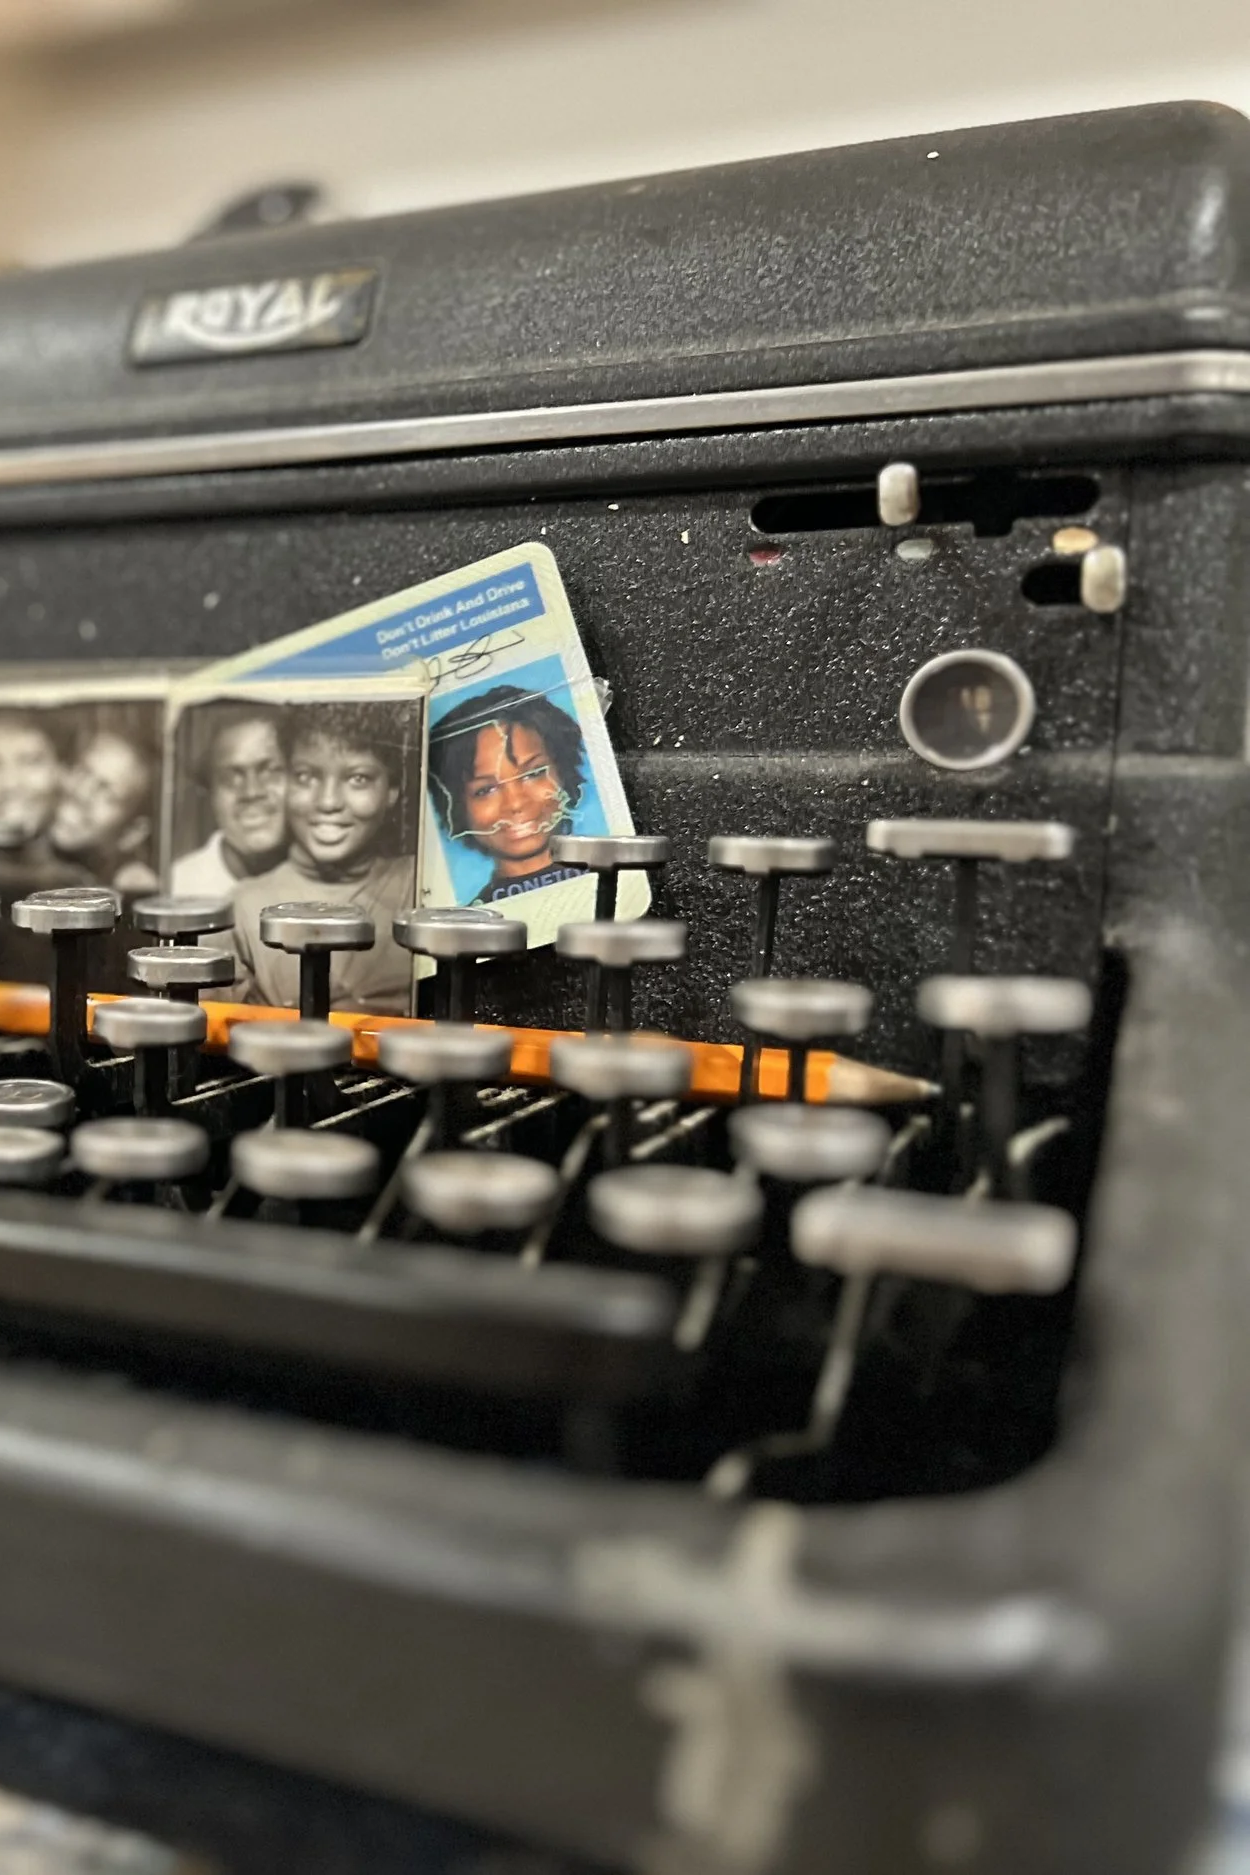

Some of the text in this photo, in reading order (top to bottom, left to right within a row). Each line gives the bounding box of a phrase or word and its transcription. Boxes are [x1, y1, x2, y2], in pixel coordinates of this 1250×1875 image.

[162, 271, 342, 350] ROYAL
[376, 579, 526, 645] Don't Drink And Drive
[381, 597, 530, 660] Don't Litter Louisiana
